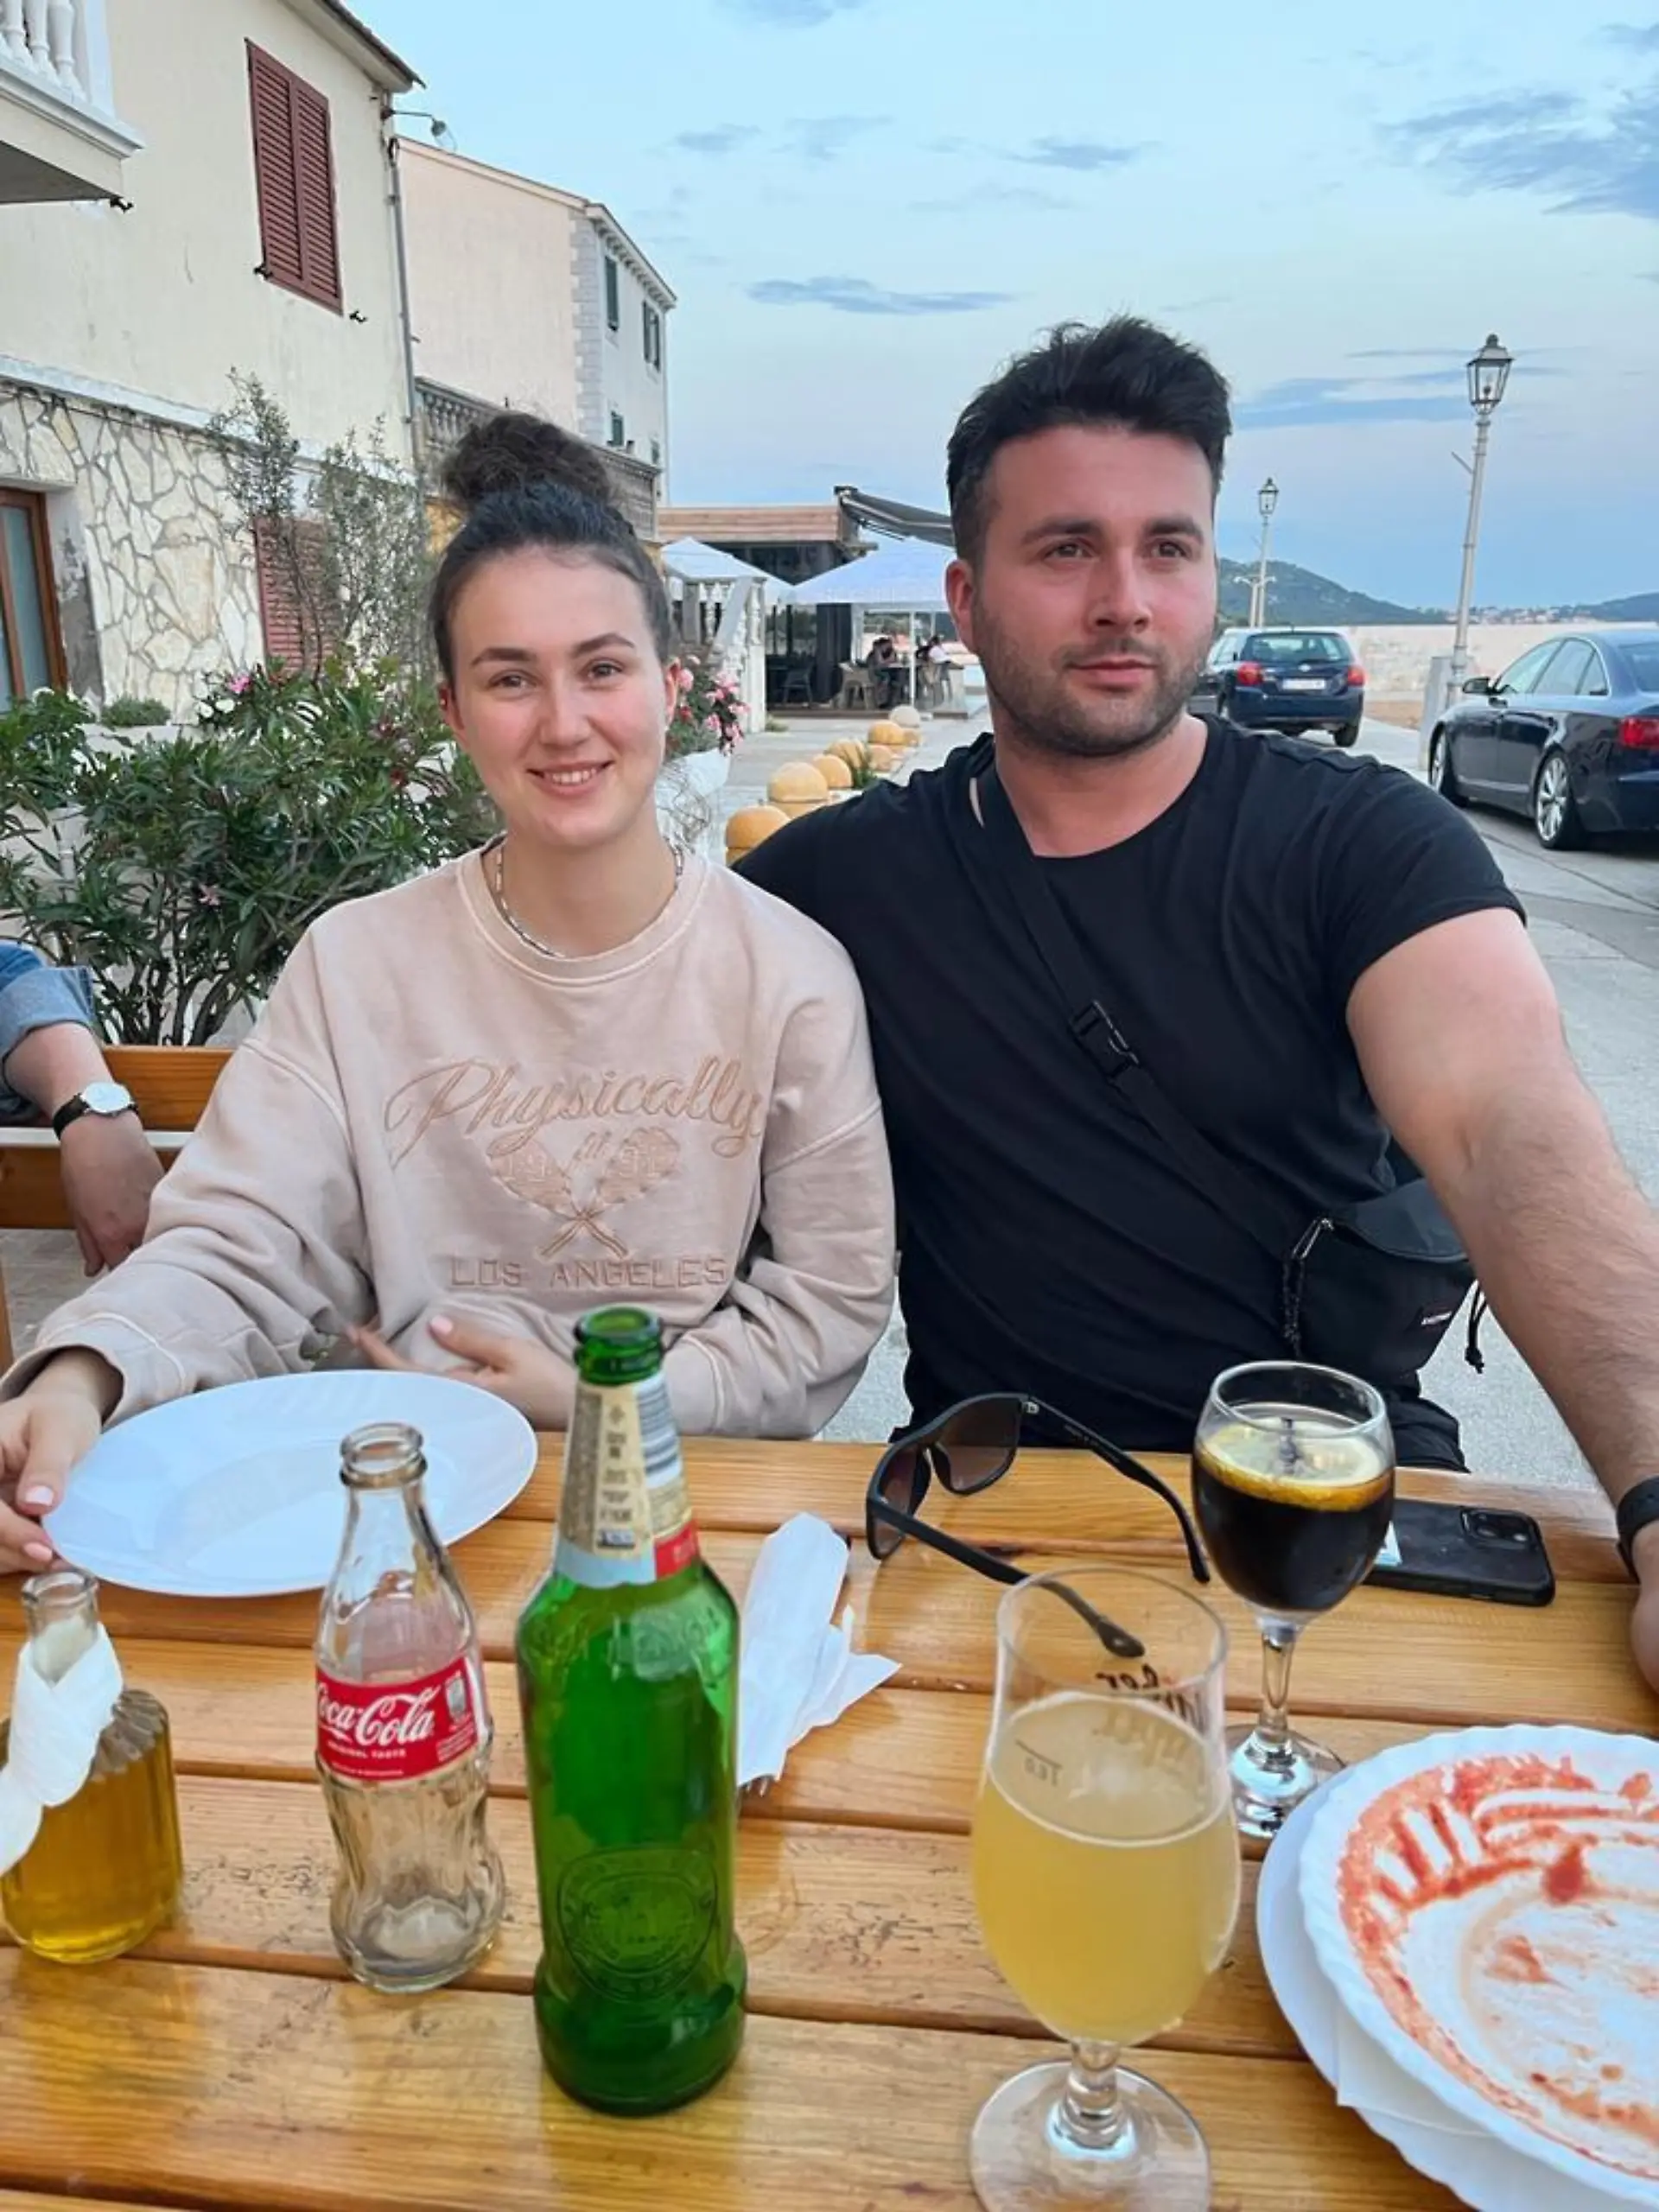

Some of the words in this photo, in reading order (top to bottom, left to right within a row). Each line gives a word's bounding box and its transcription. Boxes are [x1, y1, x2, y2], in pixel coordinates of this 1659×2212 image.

[384, 1055, 763, 1170] Physically
[450, 1257, 522, 1287] LOS
[549, 1256, 728, 1289] ANGELES
